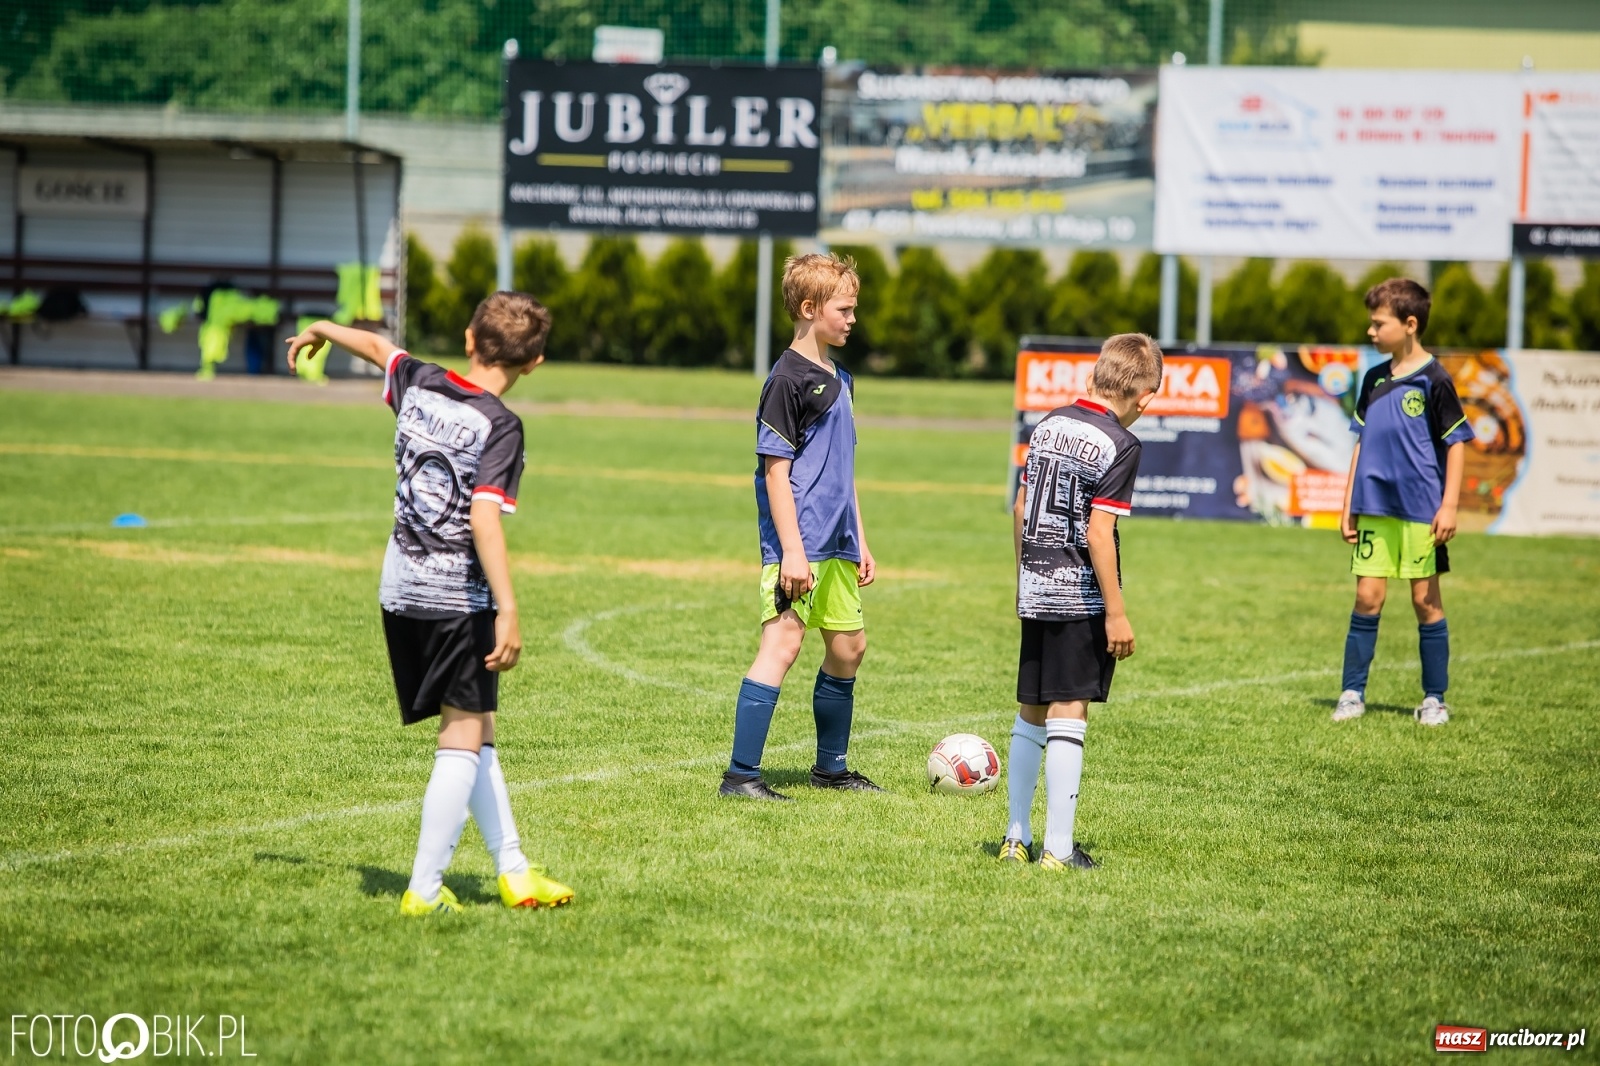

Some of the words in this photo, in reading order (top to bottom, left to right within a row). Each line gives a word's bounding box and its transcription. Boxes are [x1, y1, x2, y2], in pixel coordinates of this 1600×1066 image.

[608, 150, 722, 176] POŚPIECH
[427, 413, 477, 448] UNITED
[1054, 432, 1101, 463] UNITED
[1026, 455, 1083, 545] 14
[1356, 529, 1375, 560] 15
